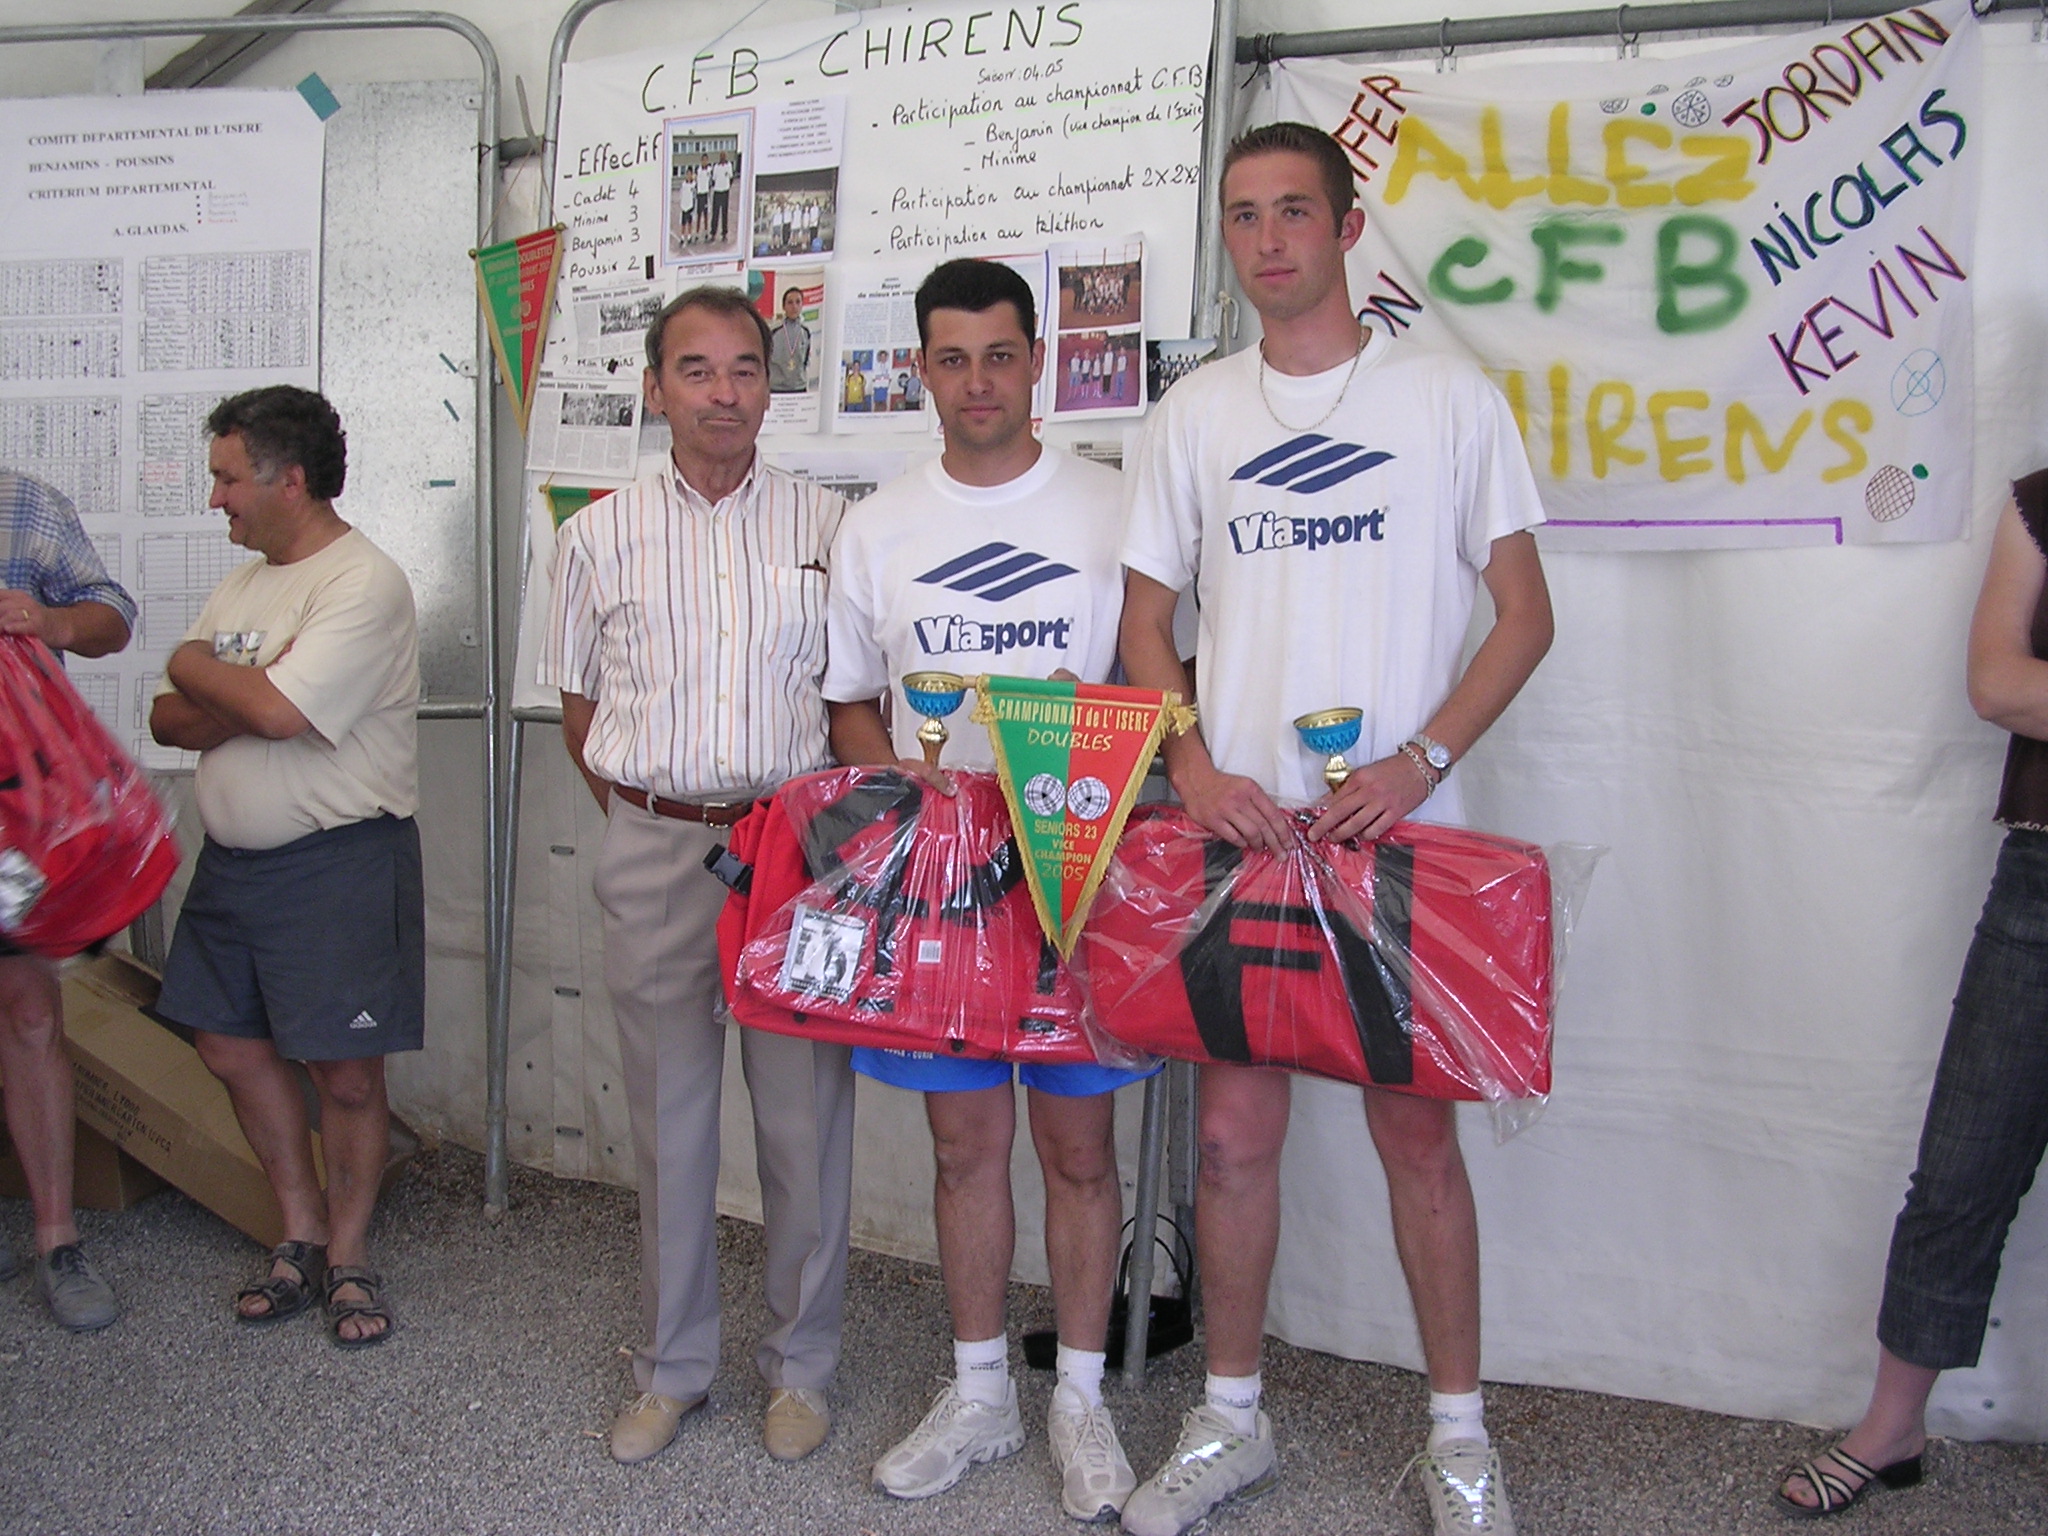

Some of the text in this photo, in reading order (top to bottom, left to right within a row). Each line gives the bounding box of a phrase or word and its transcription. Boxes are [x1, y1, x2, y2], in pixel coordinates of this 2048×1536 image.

[893, 92, 1004, 128] Participation
[1015, 95, 1037, 110] au
[1046, 67, 1143, 111] championnat
[1721, 9, 1950, 165] JORDAN
[29, 122, 263, 147] COMITE DEPARTEMENTAL DE L'ISERE
[986, 120, 1053, 153] Benjamin
[1091, 110, 1142, 133] champion
[1330, 75, 1410, 192] IFER
[29, 155, 175, 174] BENJAMINS POUSSINS
[578, 132, 663, 178] Effectif
[981, 151, 1037, 170] Minime
[1383, 102, 1757, 211] ALLEZ
[29, 180, 216, 201] CRITERIUM DEPARTEMENTAL
[574, 179, 639, 207] Cadet 4
[891, 187, 998, 219] Participation
[1014, 186, 1039, 200] au
[1048, 164, 1134, 205] championnat
[628, 205, 639, 223] 3
[572, 227, 640, 259] Benjamin 3
[890, 223, 987, 253] Participation
[998, 228, 1023, 241] au
[628, 255, 640, 271] 2
[1505, 362, 1875, 484] IRENS
[1228, 510, 1385, 555] Viasport
[912, 614, 1070, 656] Viasport
[998, 698, 1083, 727] CHAMPIONNAT
[1085, 707, 1099, 728] de
[1116, 709, 1150, 733] ISERE
[1027, 727, 1114, 752] DOUBLES
[1034, 819, 1098, 841] SENIORS 23
[1034, 849, 1092, 865] CHAMPION
